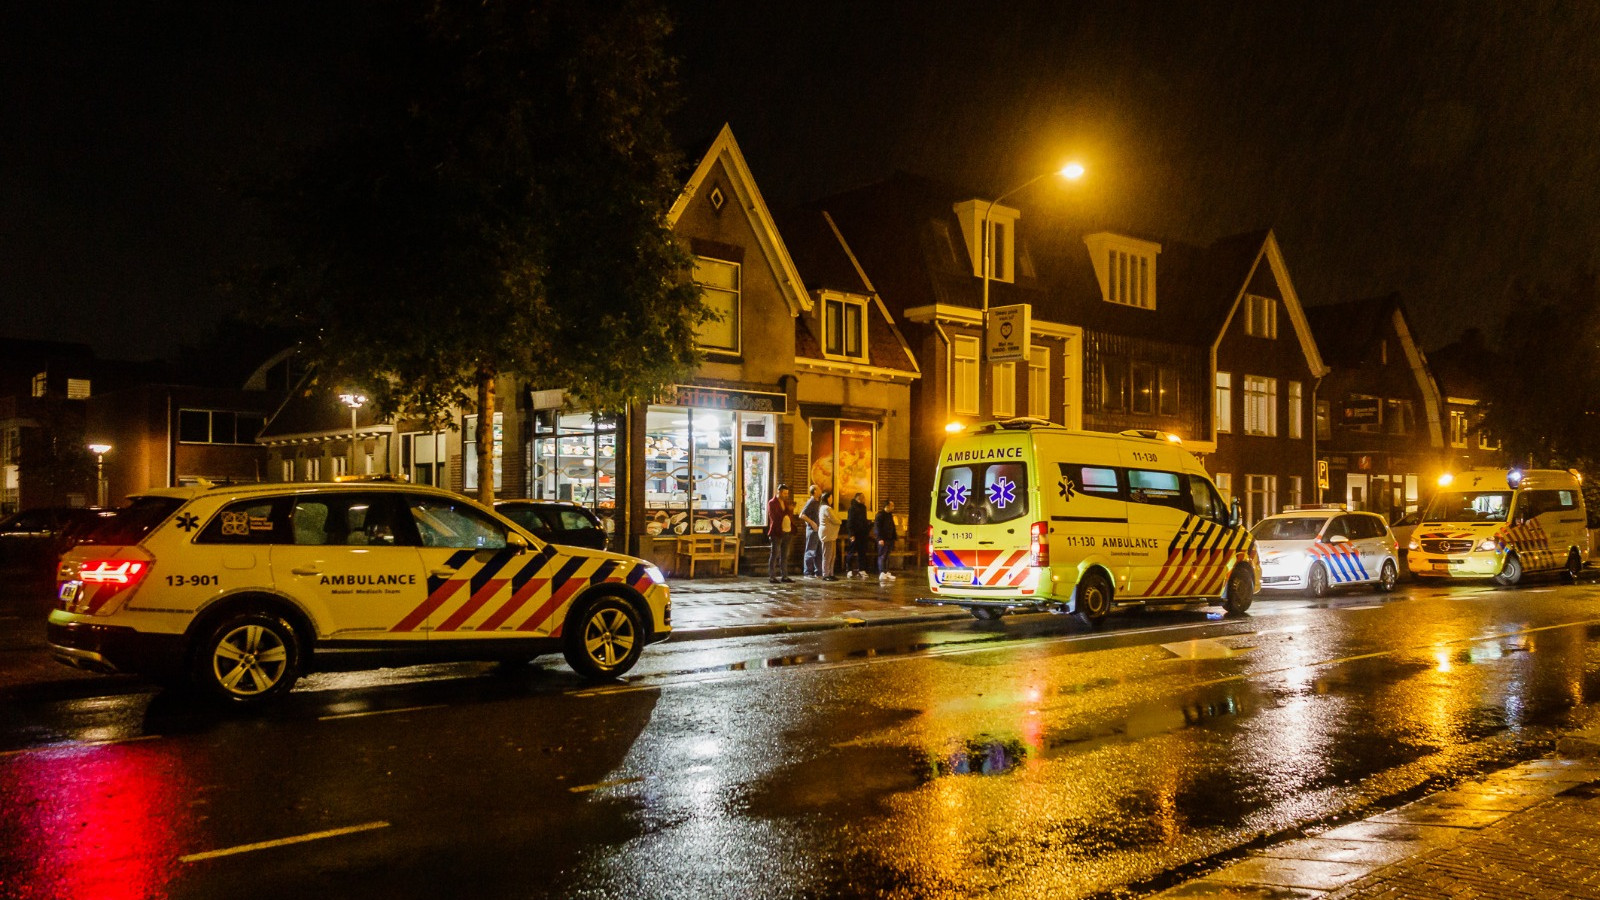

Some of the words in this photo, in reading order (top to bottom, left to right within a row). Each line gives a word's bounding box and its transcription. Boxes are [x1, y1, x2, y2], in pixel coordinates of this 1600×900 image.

[947, 447, 1023, 462] AMBULANCE
[1133, 452, 1158, 462] 11-130
[1320, 463, 1326, 476] P
[952, 532, 973, 540] 11-130
[1067, 536, 1096, 547] 11-130
[1102, 537, 1159, 548] AMBULANCE
[166, 574, 219, 587] 13-901
[320, 574, 417, 585] AMBULANCE
